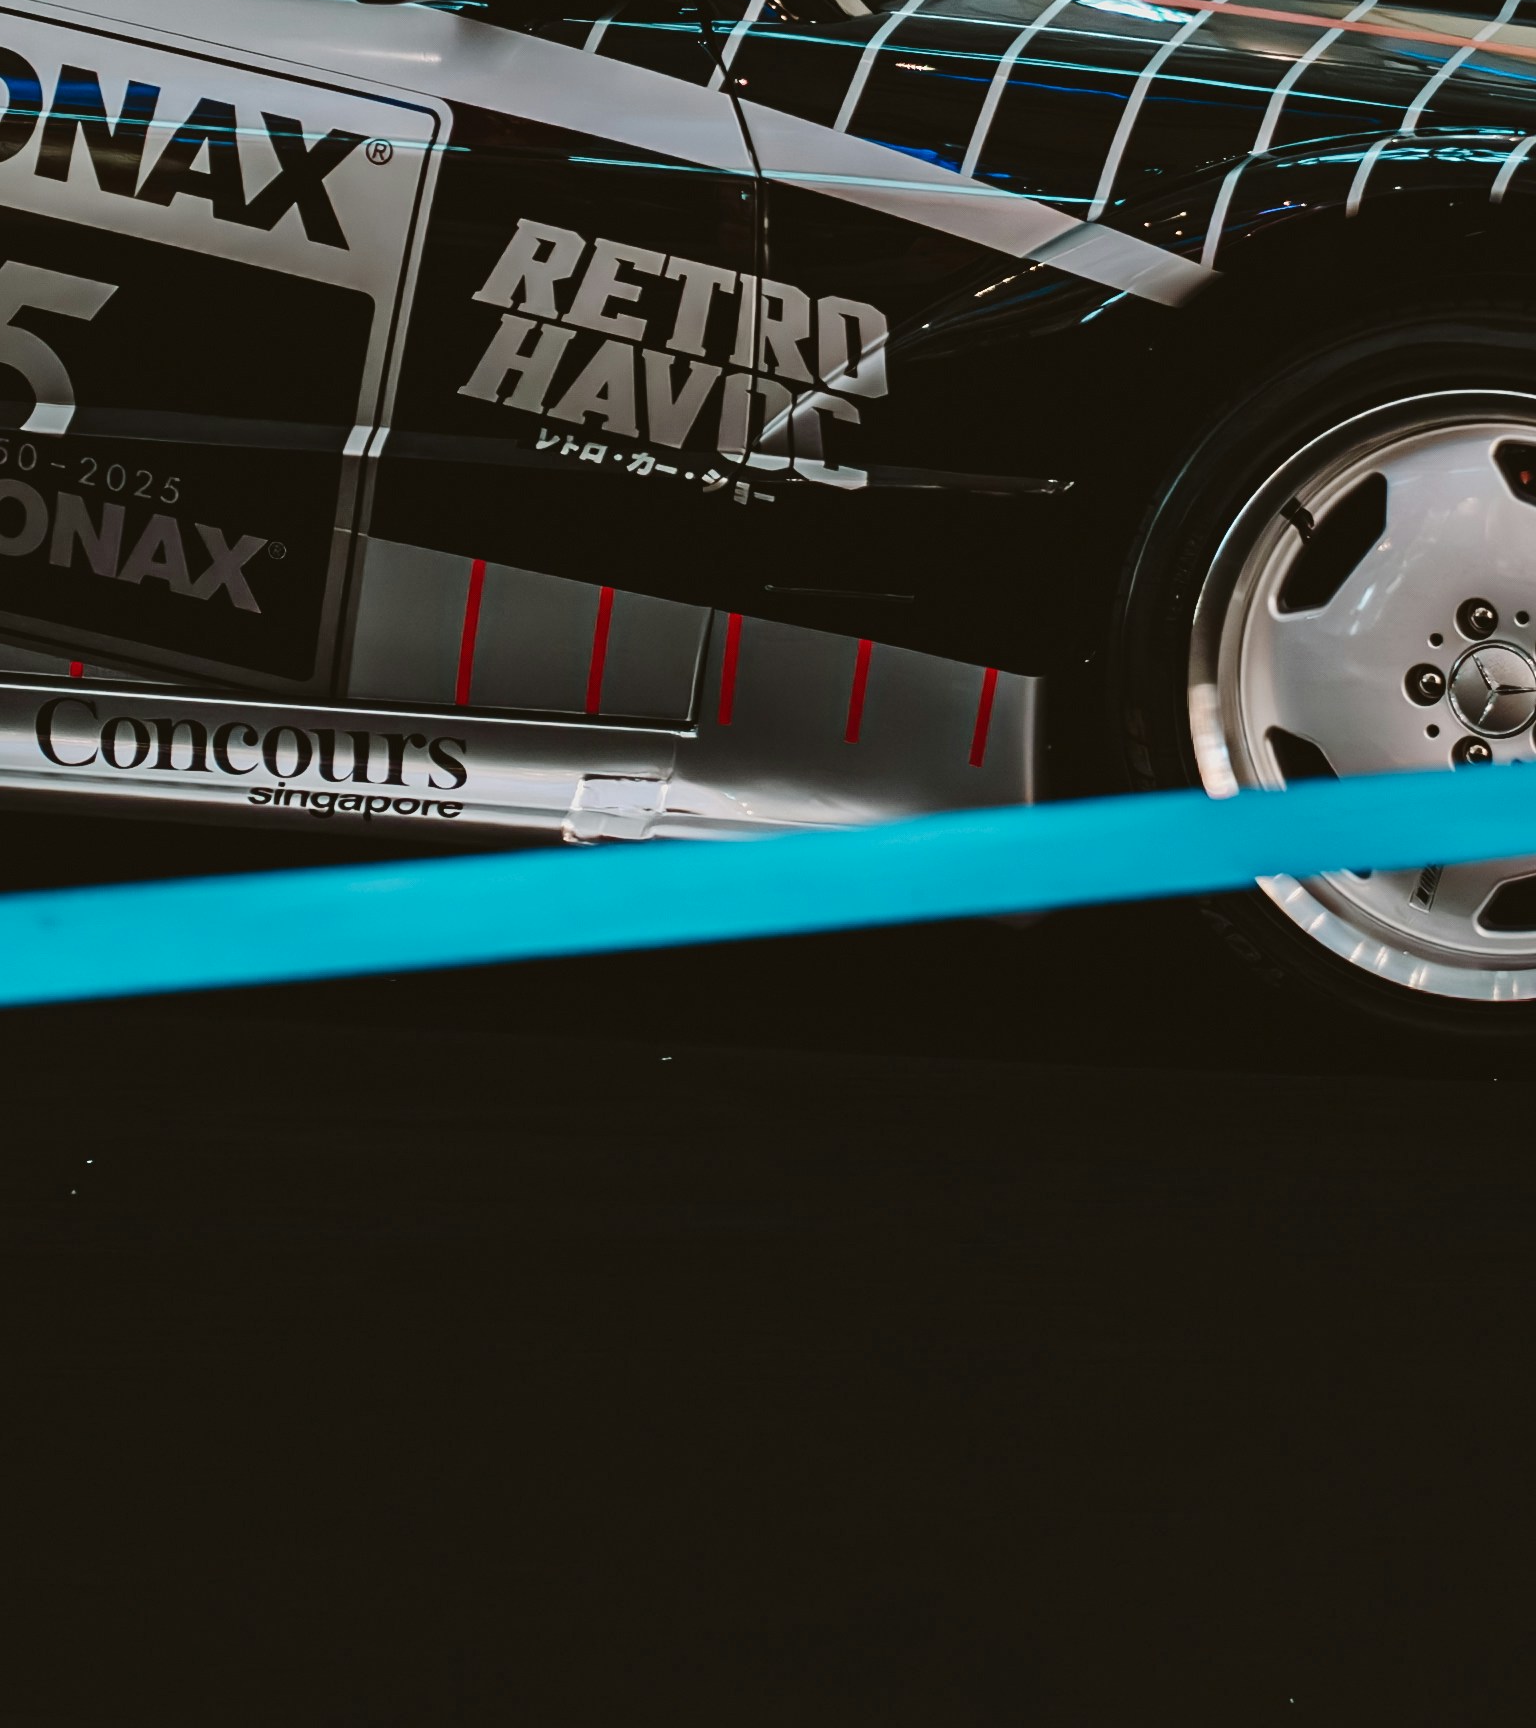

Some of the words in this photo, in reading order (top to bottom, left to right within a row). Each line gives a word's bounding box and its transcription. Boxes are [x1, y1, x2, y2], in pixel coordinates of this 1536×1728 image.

[471, 217, 890, 400] RETRO
[457, 312, 869, 491] HAVOC
[35, 696, 470, 791] Concours
[247, 781, 464, 822] singapore
